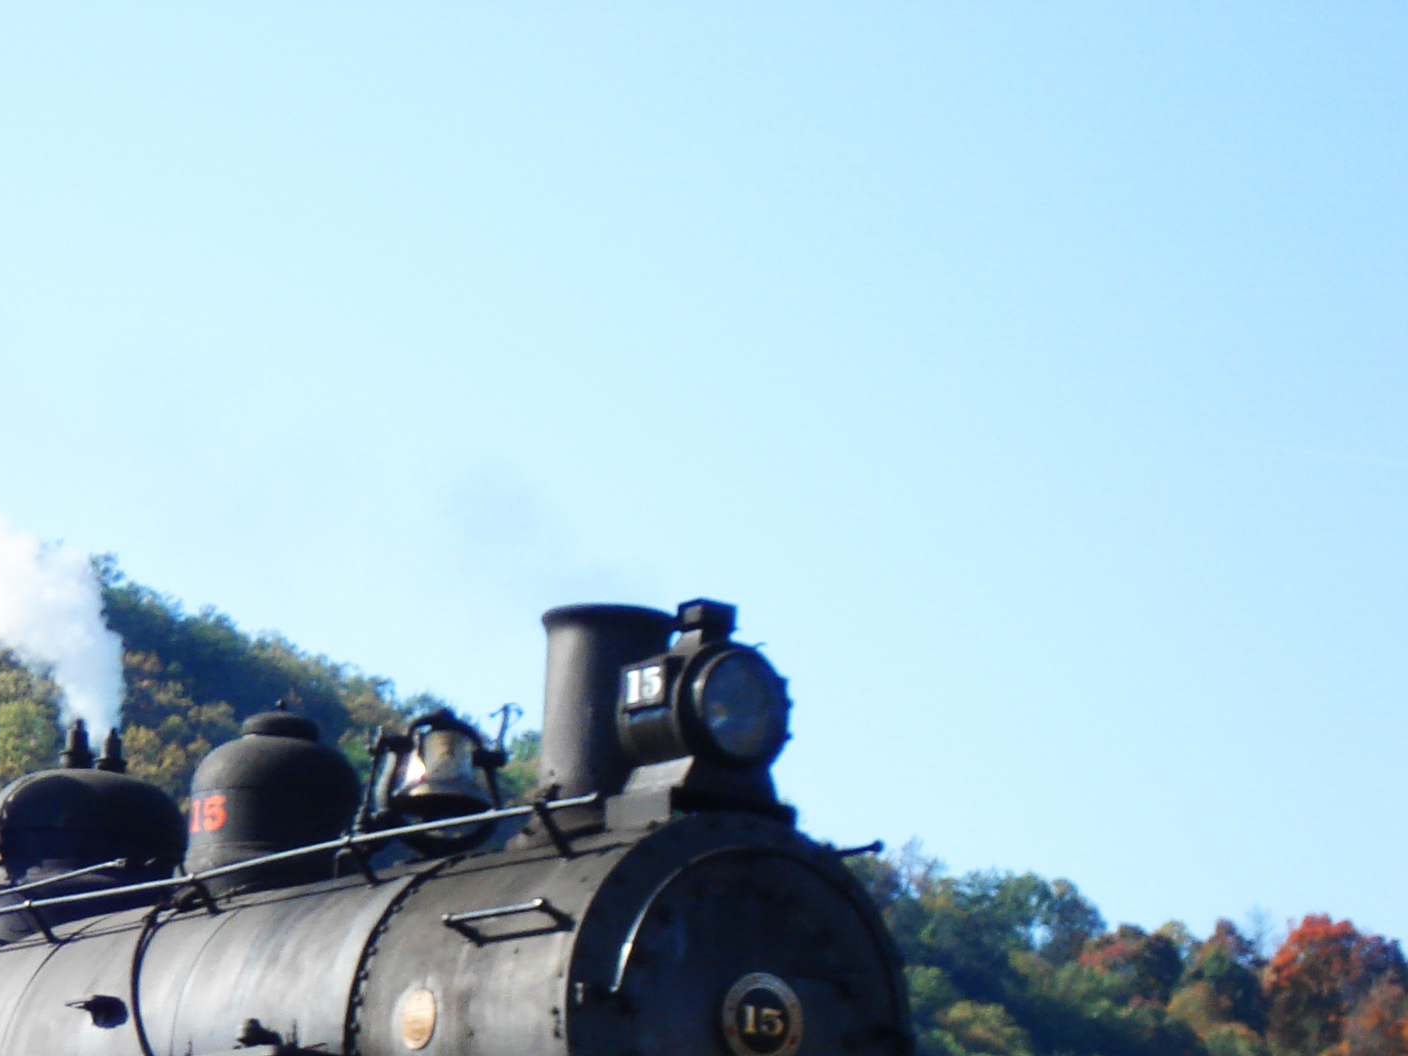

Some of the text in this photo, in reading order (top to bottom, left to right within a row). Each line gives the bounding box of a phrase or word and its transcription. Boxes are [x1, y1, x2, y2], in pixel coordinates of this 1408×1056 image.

[626, 665, 662, 704] 15
[190, 794, 228, 834] 15
[744, 1004, 784, 1035] 15
